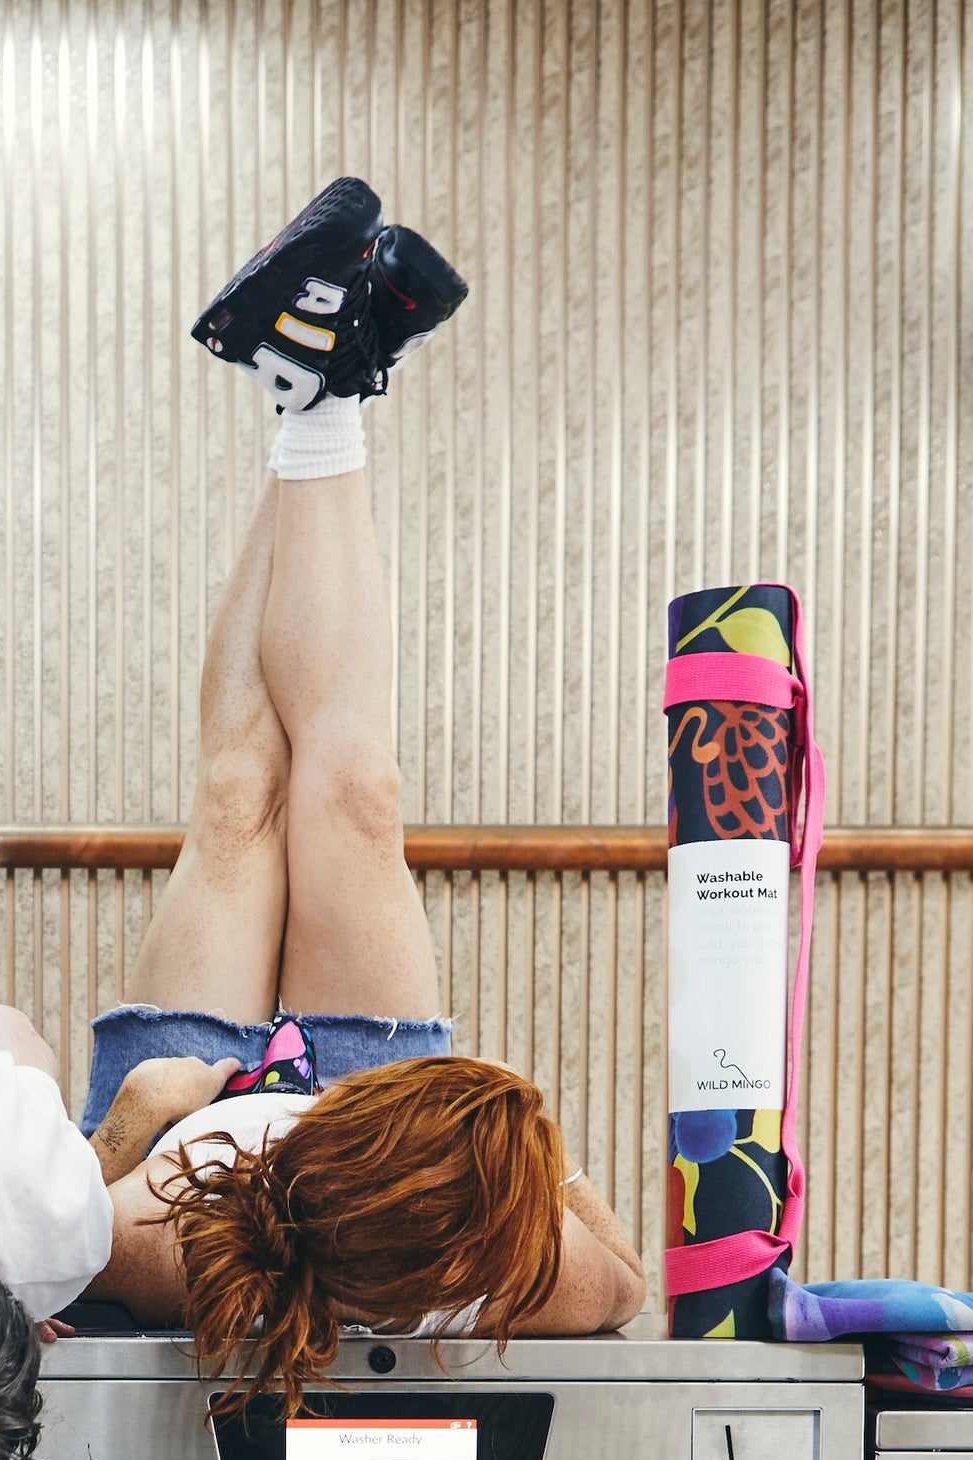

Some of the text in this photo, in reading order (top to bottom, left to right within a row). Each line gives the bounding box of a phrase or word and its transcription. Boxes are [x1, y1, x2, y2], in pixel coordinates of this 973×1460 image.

[696, 871, 764, 884] Washable
[696, 888, 778, 900] Workout Mat
[697, 1079, 771, 1090] WILD MINGO
[339, 1433, 423, 1446] Washer Ready
